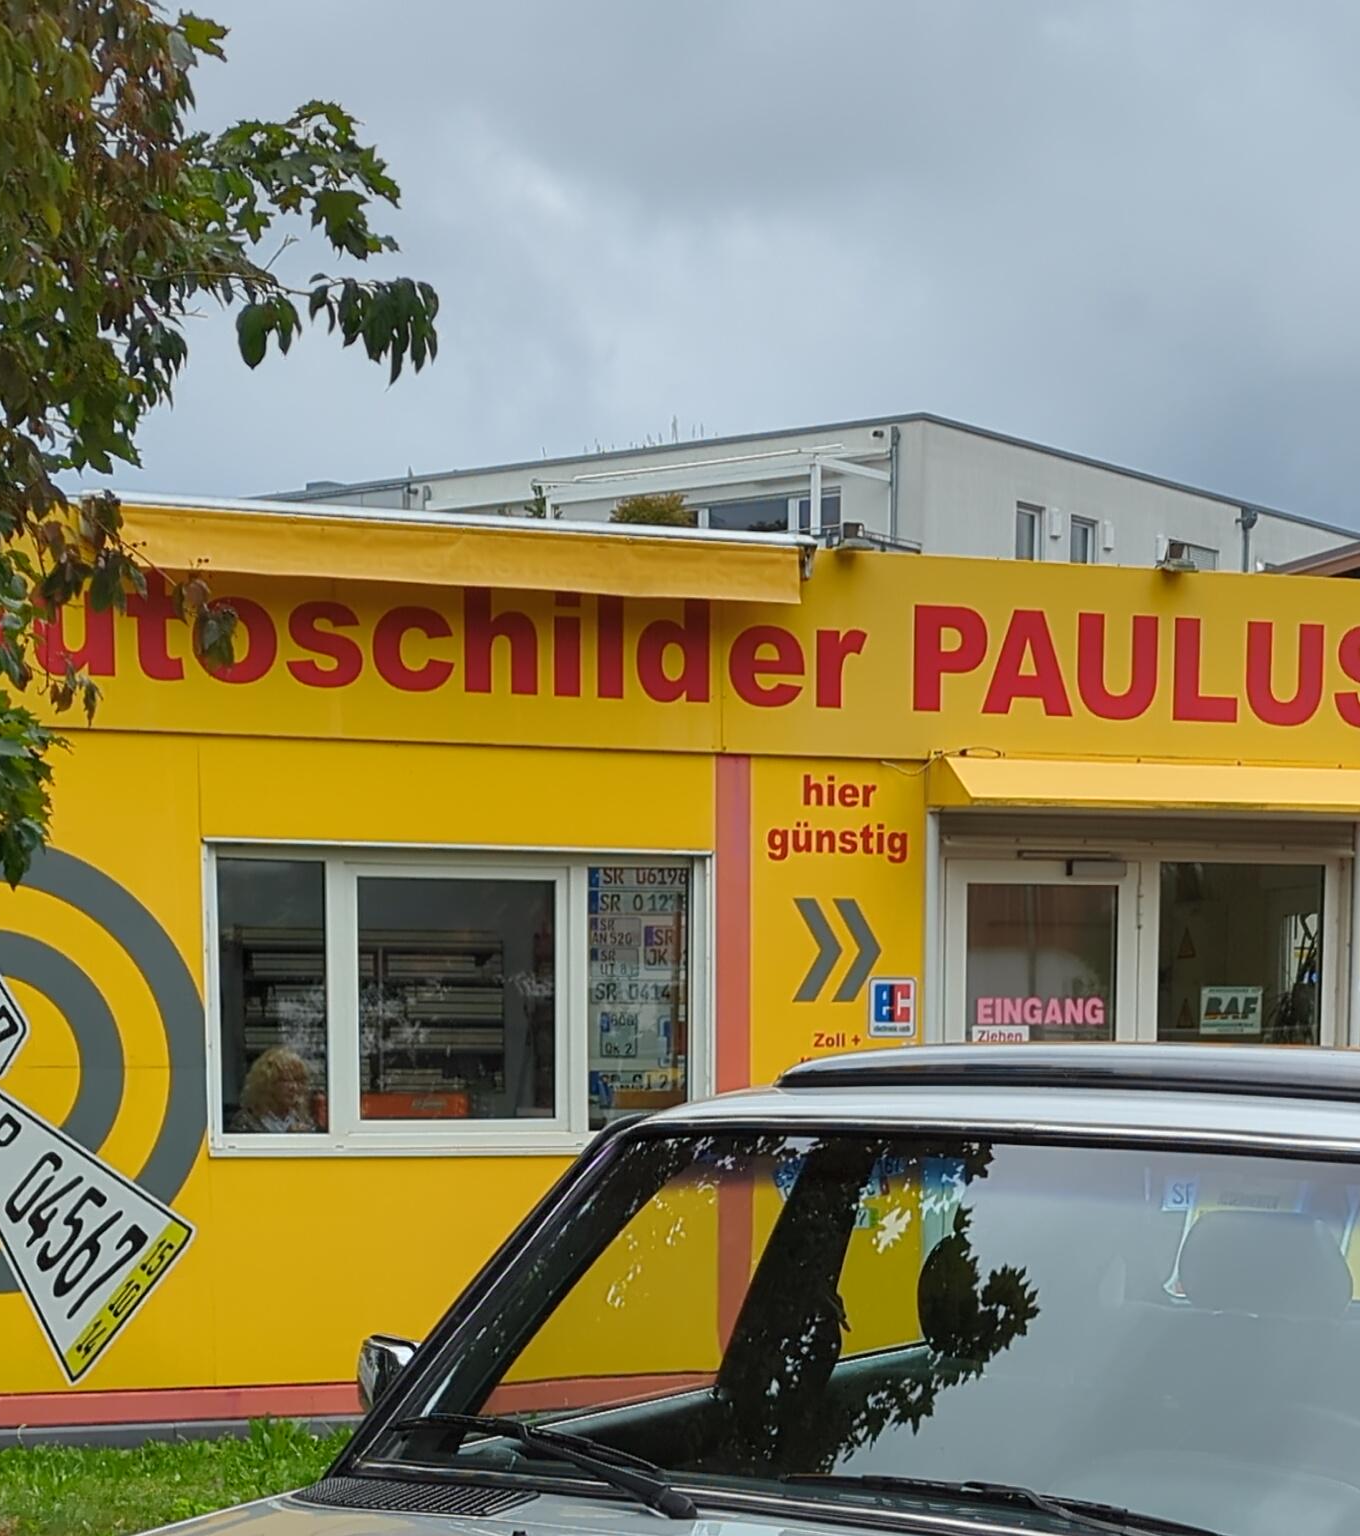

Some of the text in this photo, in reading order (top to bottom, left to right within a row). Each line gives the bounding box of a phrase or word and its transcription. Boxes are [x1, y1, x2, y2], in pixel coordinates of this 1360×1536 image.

[802, 774, 878, 808] hier
[767, 821, 909, 864] günstig
[599, 893, 621, 912] SR
[595, 982, 617, 1001] SR
[976, 997, 1105, 1025] EINGANG
[813, 1032, 846, 1048] Zoll
[976, 1029, 1023, 1043] Ziehen
[4, 1150, 150, 1321] 04567
